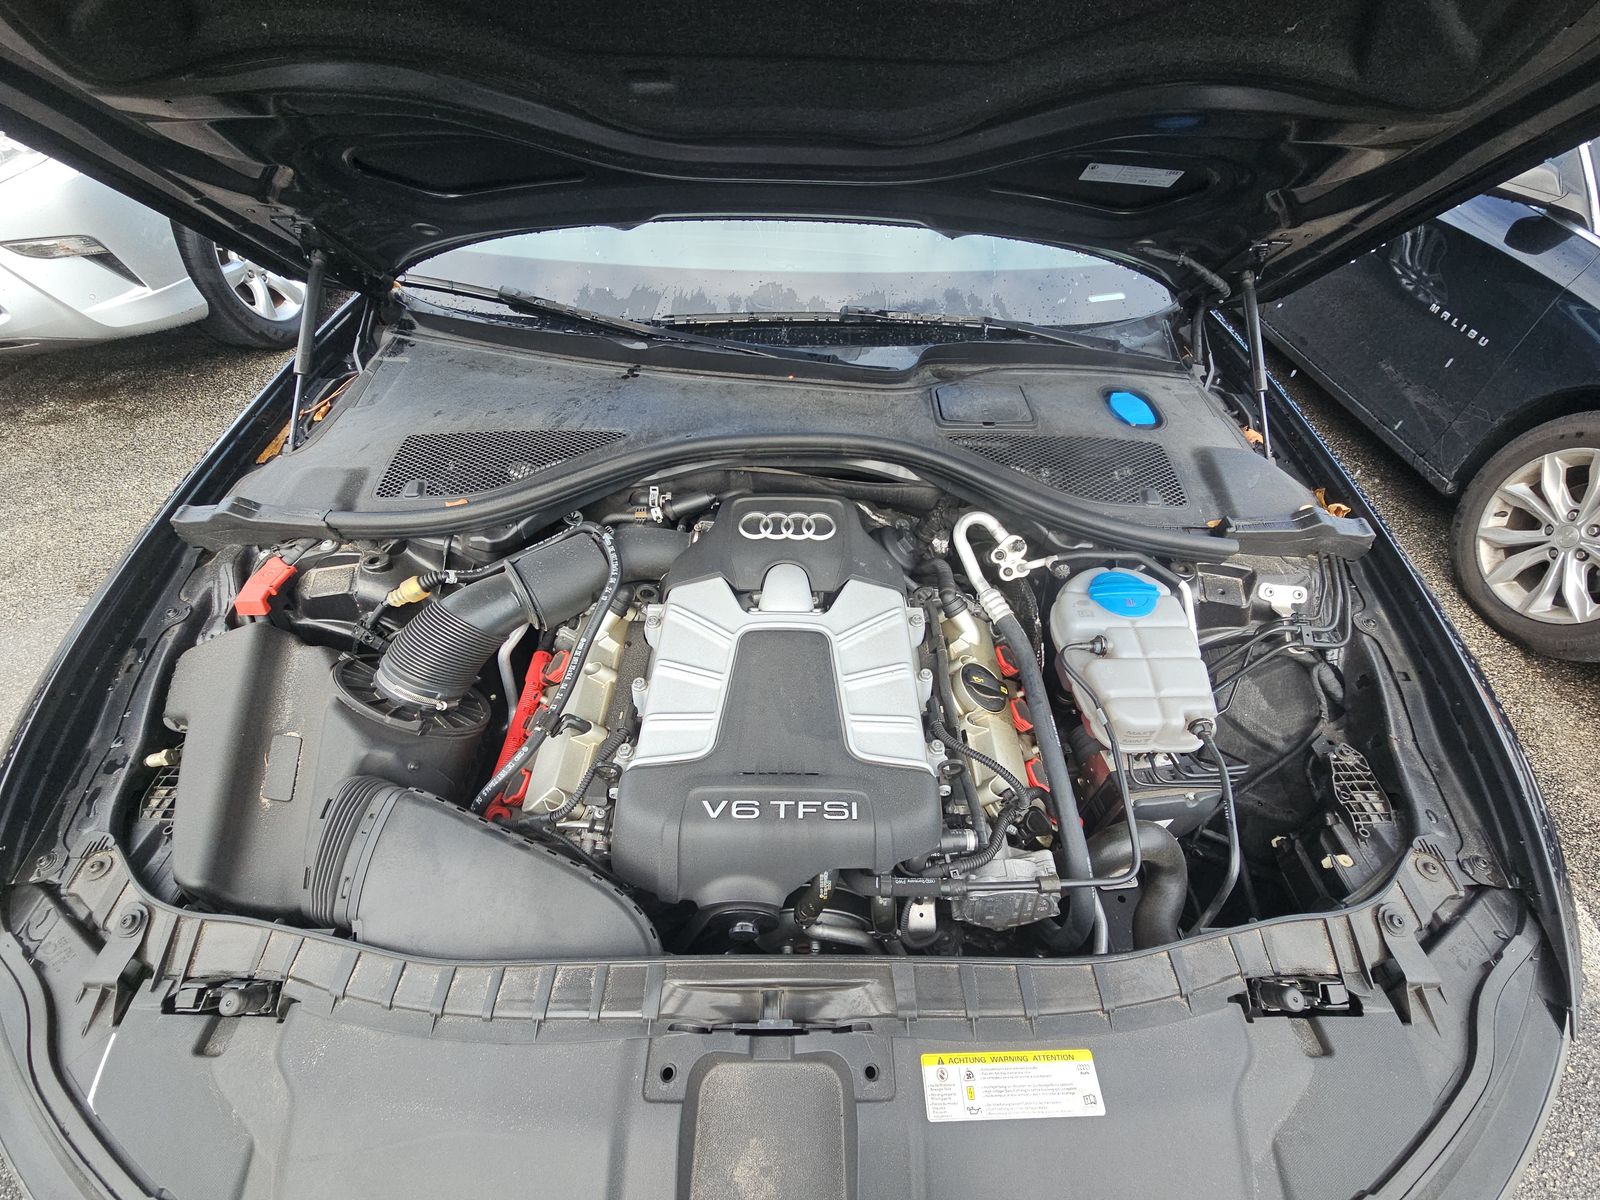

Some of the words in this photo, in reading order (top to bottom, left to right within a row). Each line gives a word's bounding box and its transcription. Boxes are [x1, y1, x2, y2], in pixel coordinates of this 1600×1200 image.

[1429, 303, 1489, 347] MALIBU
[702, 800, 760, 819] V6
[770, 801, 858, 820] TFSI
[1032, 1054, 1074, 1062] ATTENTION
